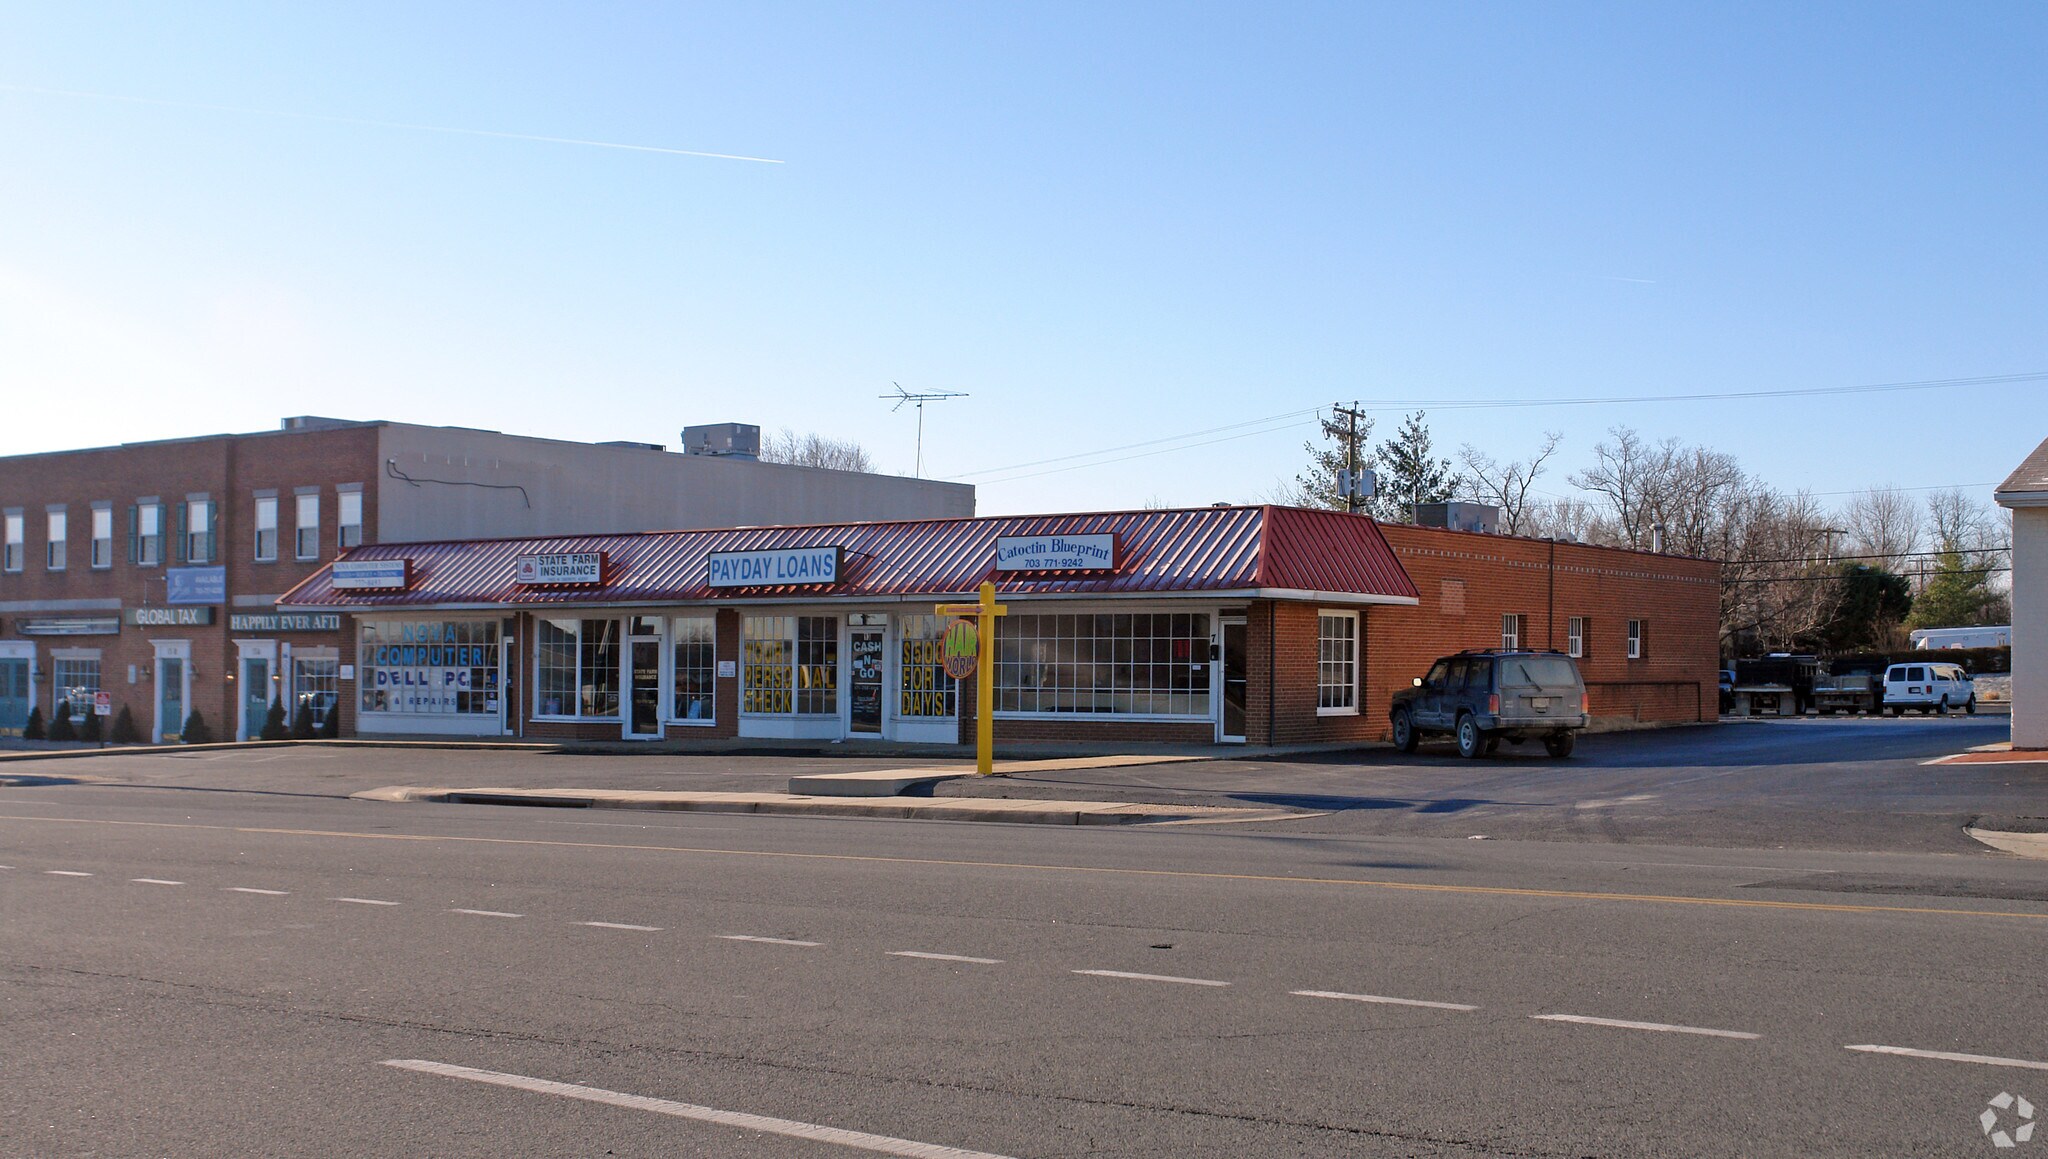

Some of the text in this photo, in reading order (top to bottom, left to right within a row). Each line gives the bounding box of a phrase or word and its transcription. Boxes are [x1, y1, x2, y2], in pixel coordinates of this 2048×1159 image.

[998, 538, 1109, 562] Catoctin Blueprint
[538, 554, 598, 566] STATE FARM
[711, 553, 833, 581] PAYDAY LOANS
[1025, 559, 1041, 568] 703
[540, 565, 596, 576] INSURANCE
[136, 608, 198, 624] GLOBAL TAX
[231, 614, 340, 630] HAPPILY EVER AFT
[403, 624, 455, 642] NOVA
[945, 622, 977, 656] HAIR
[1211, 633, 1216, 643] 7
[745, 642, 783, 664] YOUR
[853, 641, 882, 652] CASH
[376, 646, 483, 666] COMPUTER
[864, 654, 871, 665] N
[859, 668, 875, 679] GO
[946, 655, 976, 675] WORLD
[377, 670, 428, 685] DELL
[745, 667, 836, 689] PERSONAL
[903, 666, 932, 690] FOR
[408, 697, 456, 705] REPAIRS
[744, 691, 793, 712] CHECK
[902, 692, 943, 716] DAYS
